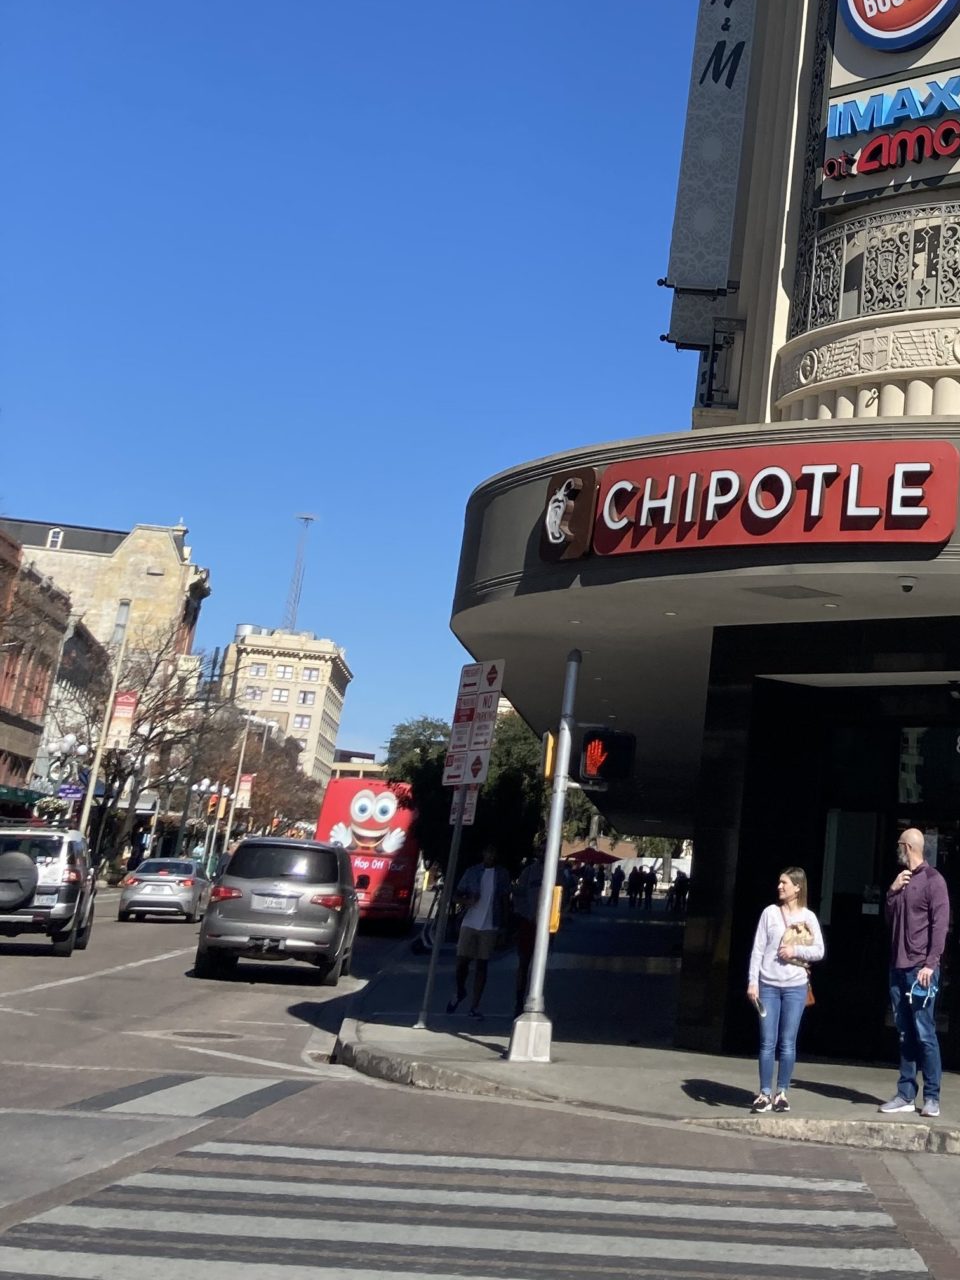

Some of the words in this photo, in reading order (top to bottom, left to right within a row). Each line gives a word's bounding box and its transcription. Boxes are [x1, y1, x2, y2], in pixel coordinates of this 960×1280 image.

[823, 151, 849, 179] at
[602, 463, 931, 530] CHIPOTLE
[482, 695, 493, 709] NO
[354, 857, 369, 870] Hop
[371, 859, 385, 869] Off
[387, 860, 407, 871] Tour
